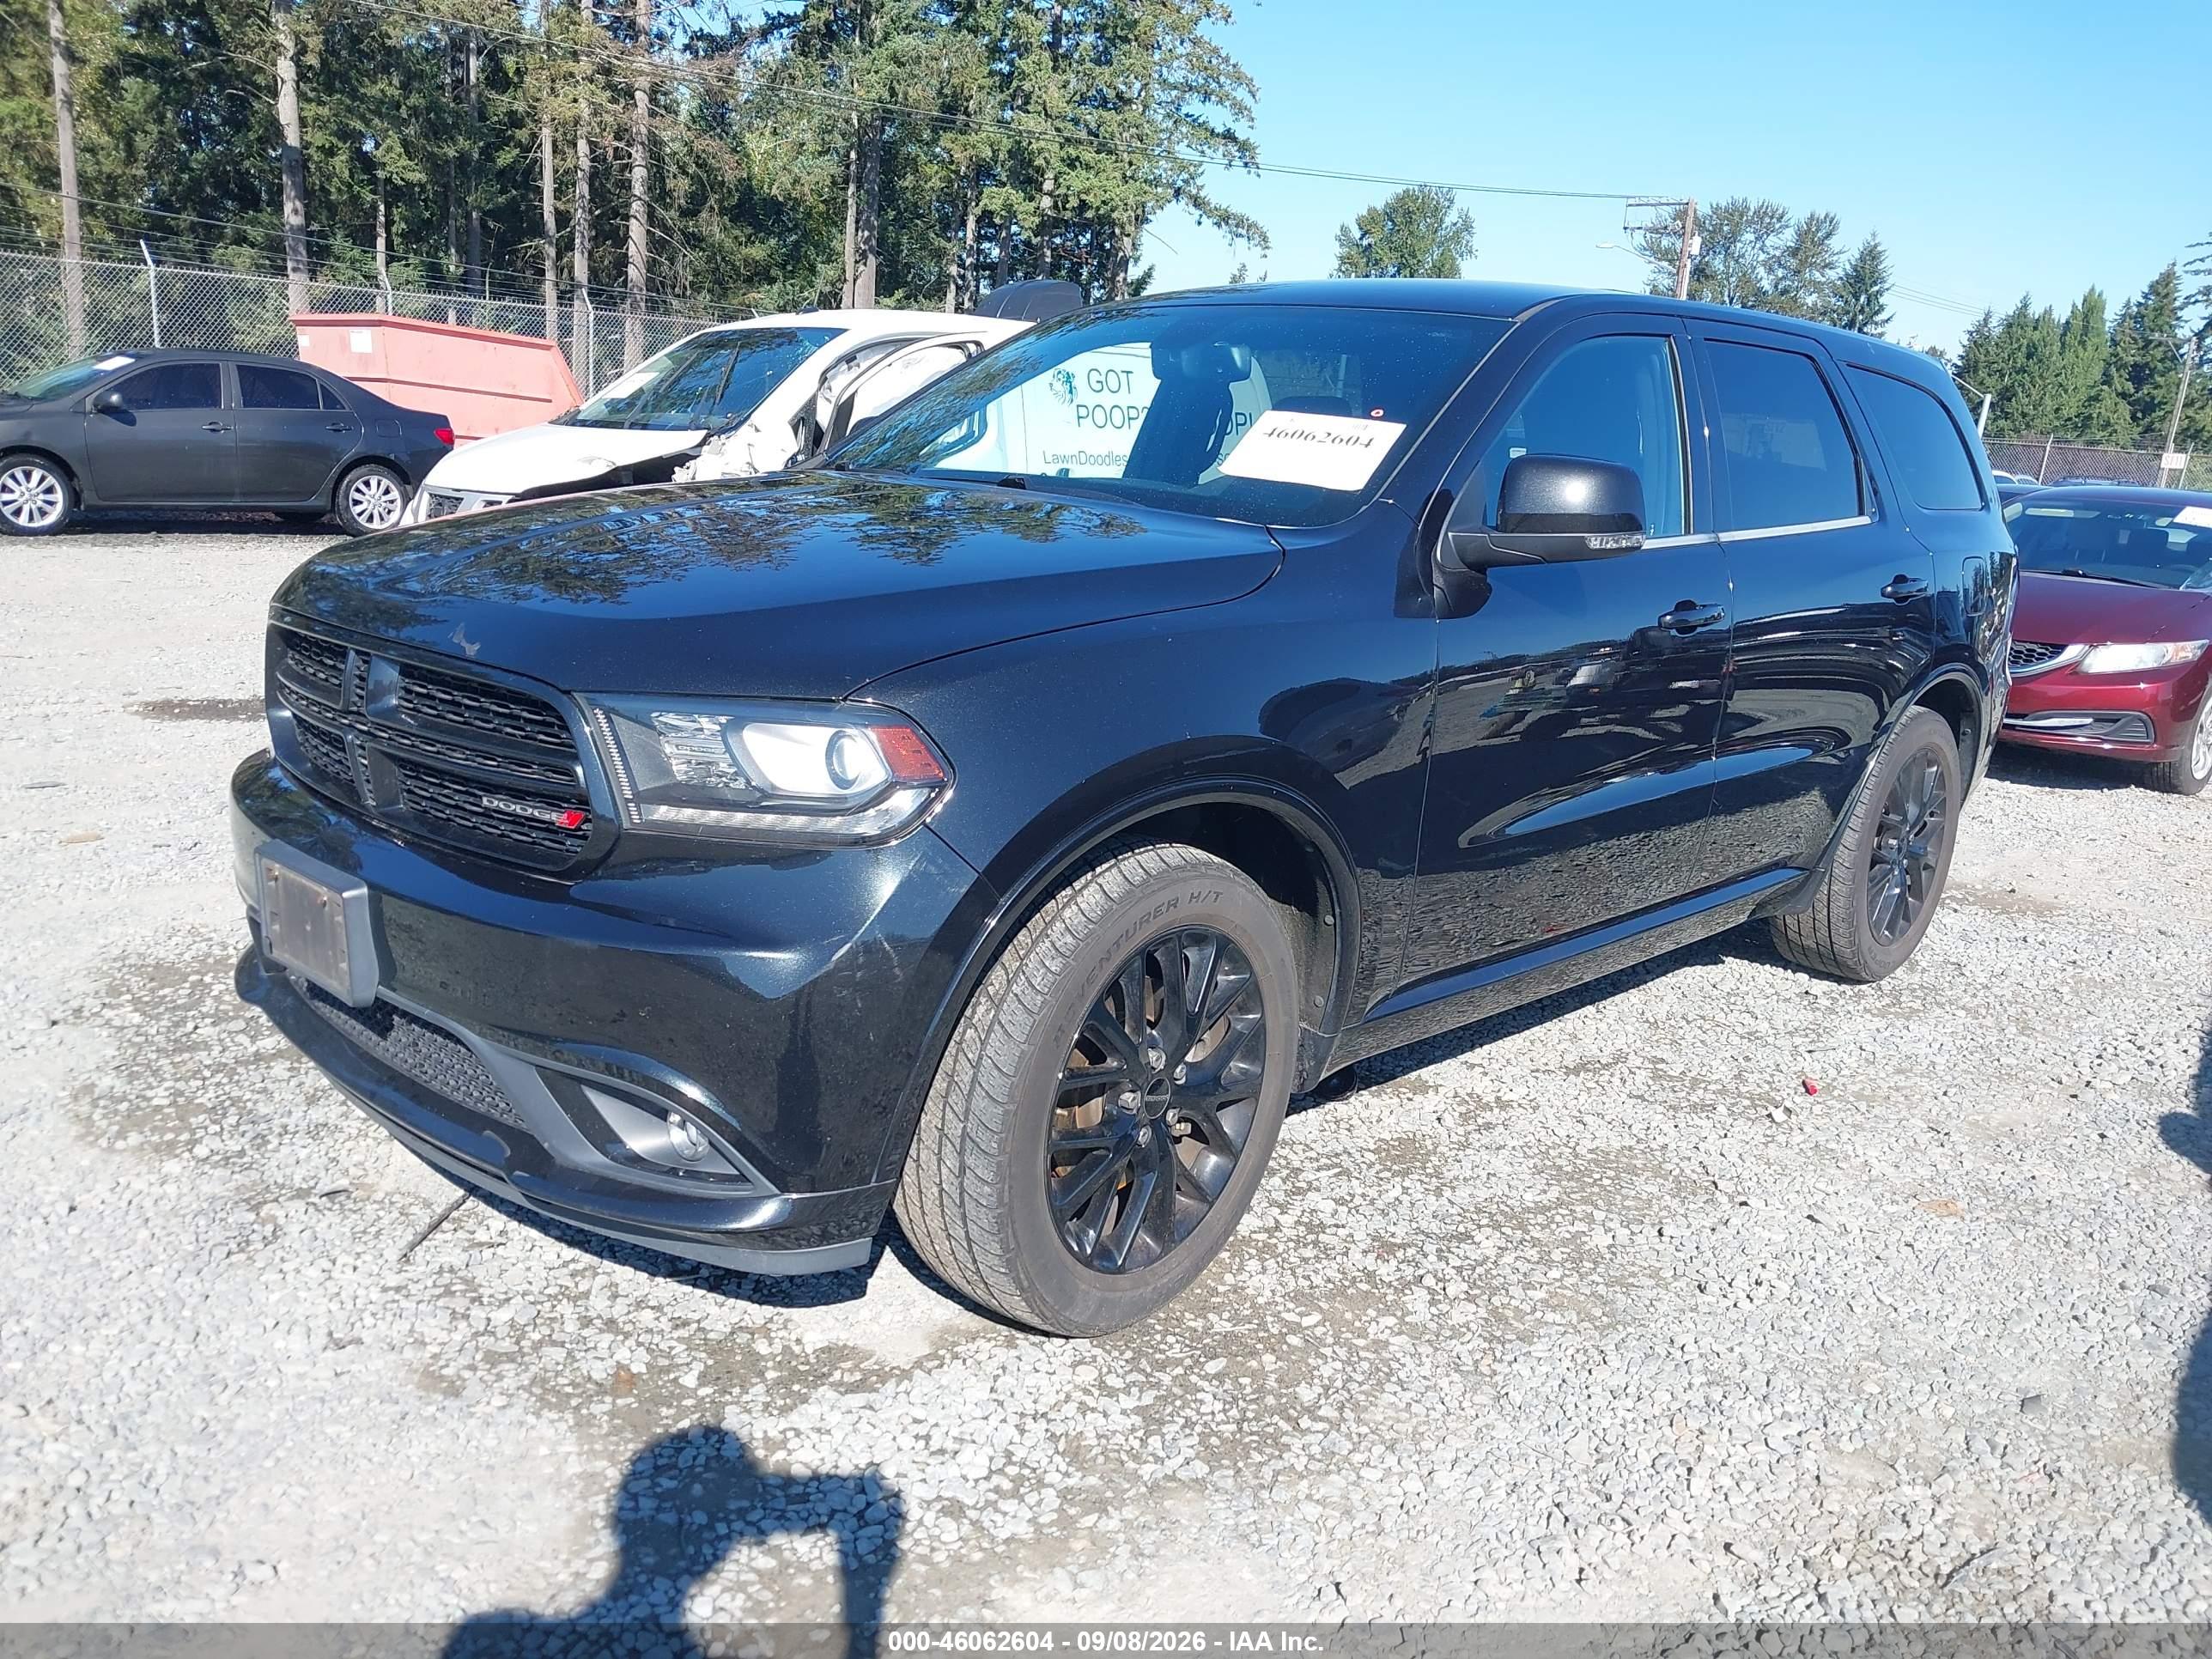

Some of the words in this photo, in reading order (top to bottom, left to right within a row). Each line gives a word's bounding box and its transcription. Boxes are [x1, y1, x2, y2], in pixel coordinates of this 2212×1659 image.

[1087, 368, 1134, 395] GOT
[1263, 427, 1375, 448] 46062604
[482, 796, 568, 821] DODGE
